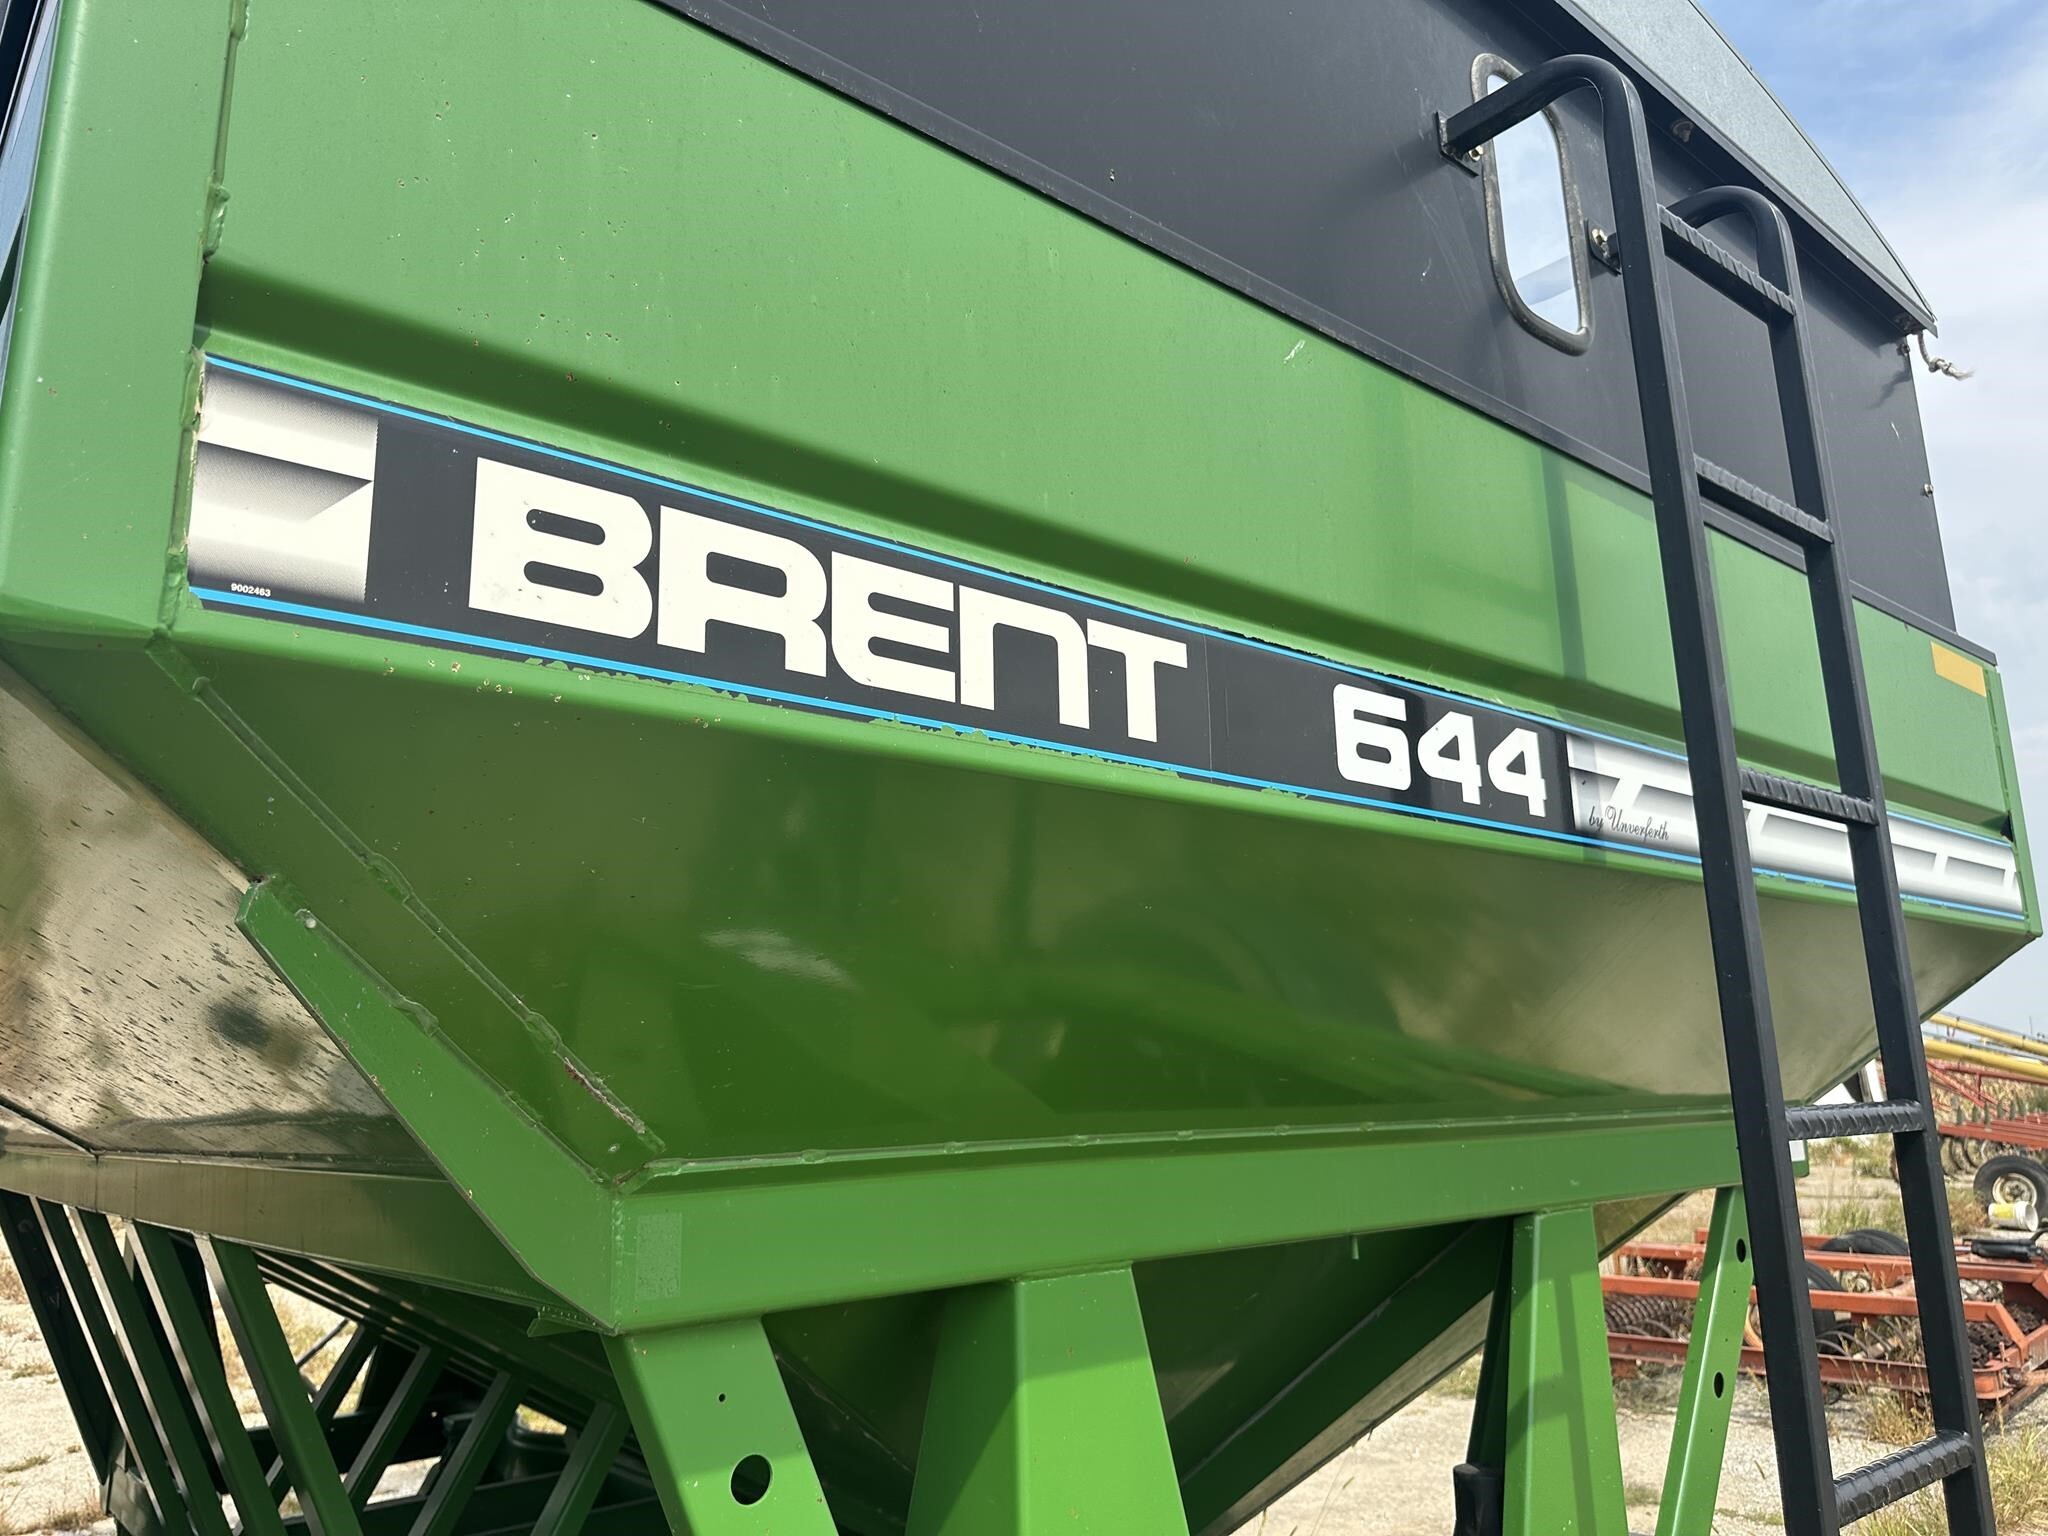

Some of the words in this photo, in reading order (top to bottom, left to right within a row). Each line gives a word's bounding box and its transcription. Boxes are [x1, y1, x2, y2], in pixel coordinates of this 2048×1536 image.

[230, 582, 271, 597] 9002463
[468, 457, 1188, 742] BRENT
[1333, 683, 1547, 817] 644
[1588, 805, 1604, 832] by
[1604, 805, 1670, 842] Unverferth
